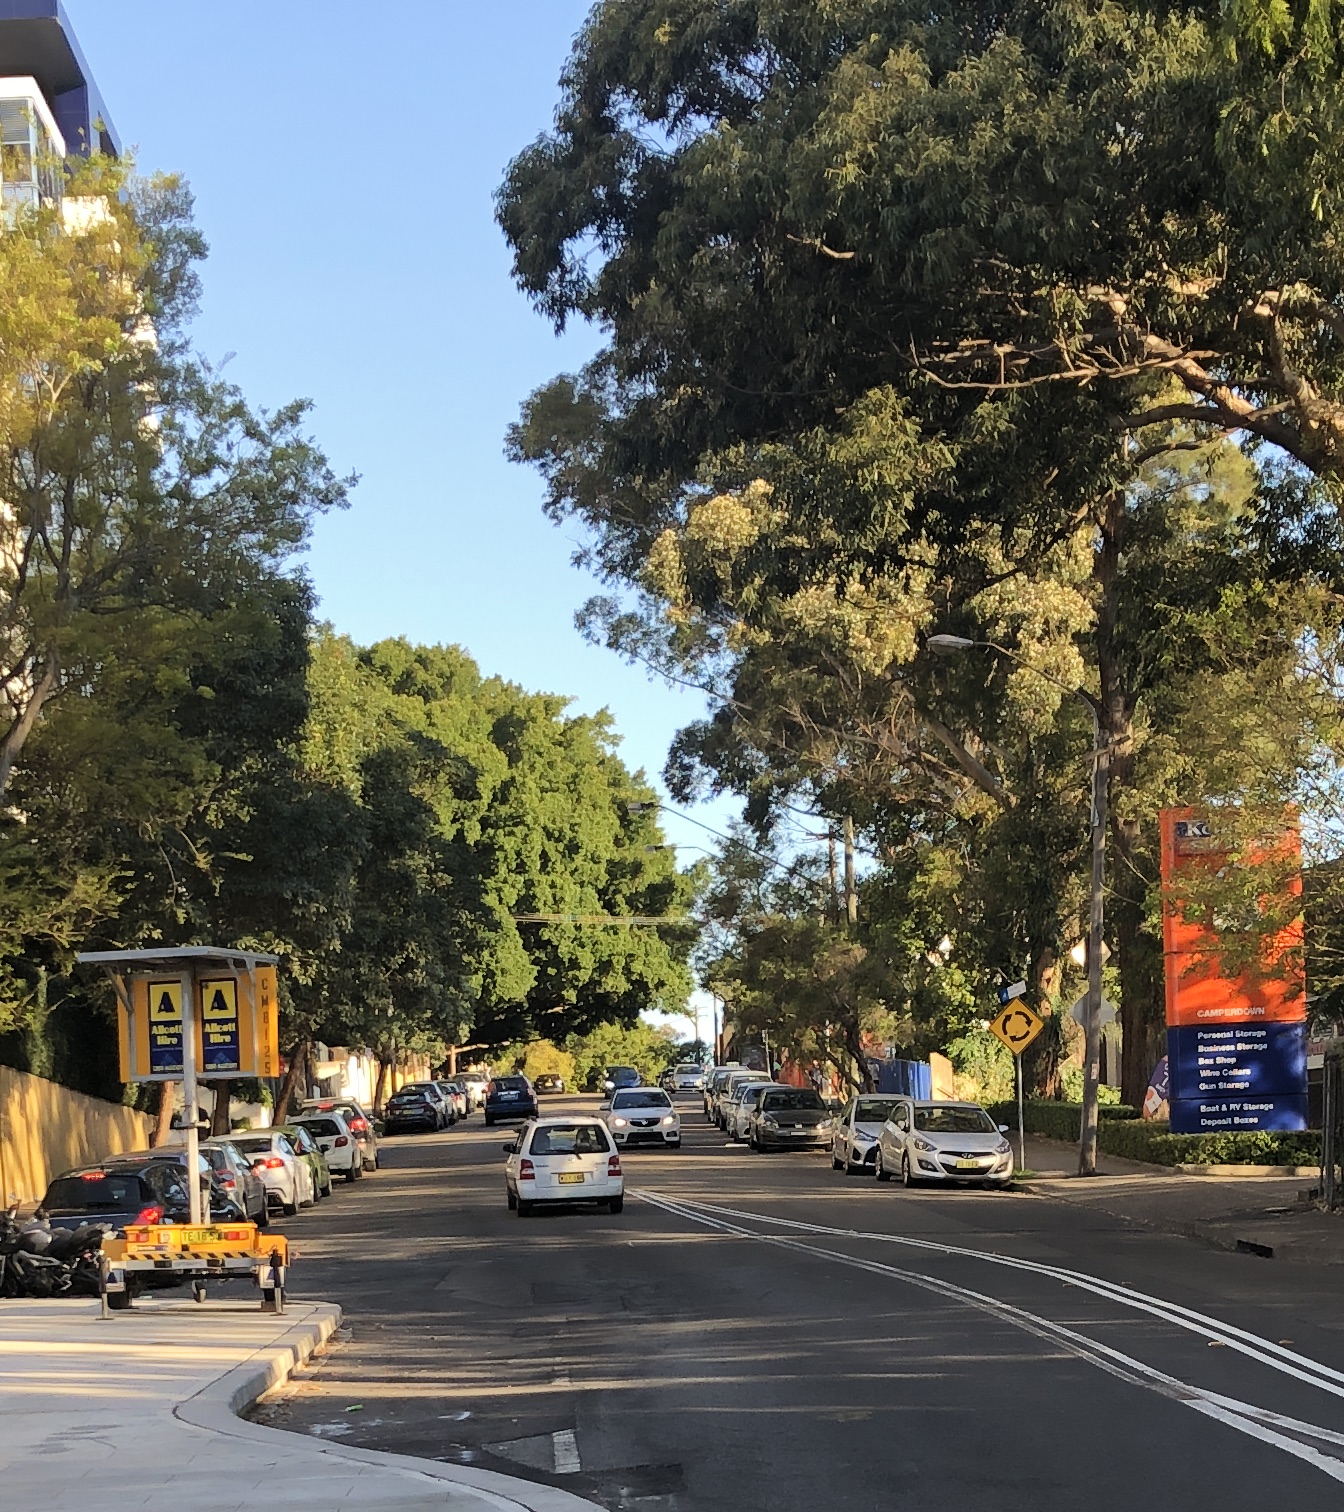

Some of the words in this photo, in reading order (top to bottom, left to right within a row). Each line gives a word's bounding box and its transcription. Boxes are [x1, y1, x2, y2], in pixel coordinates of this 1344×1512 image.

[1196, 1007, 1266, 1018] CAMPERDOWN
[157, 1035, 179, 1046] Hire
[209, 1033, 232, 1044] Hire
[1197, 1031, 1234, 1040] Personal
[1235, 1030, 1267, 1038] Storage
[1197, 1044, 1236, 1053] Business
[1236, 1042, 1268, 1051] Storage
[1197, 1057, 1215, 1066] Box
[1215, 1056, 1237, 1065] Shop
[1199, 1069, 1221, 1078] Wine
[1222, 1068, 1252, 1077] Cellars
[1198, 1082, 1217, 1091] Gun
[1218, 1081, 1250, 1090] Storage
[1199, 1104, 1220, 1113] Boat
[1221, 1103, 1228, 1112] &
[1229, 1103, 1242, 1112] RV
[1242, 1102, 1274, 1112] Storage
[1200, 1117, 1232, 1127] Deposit
[1233, 1116, 1259, 1125] Boxes
